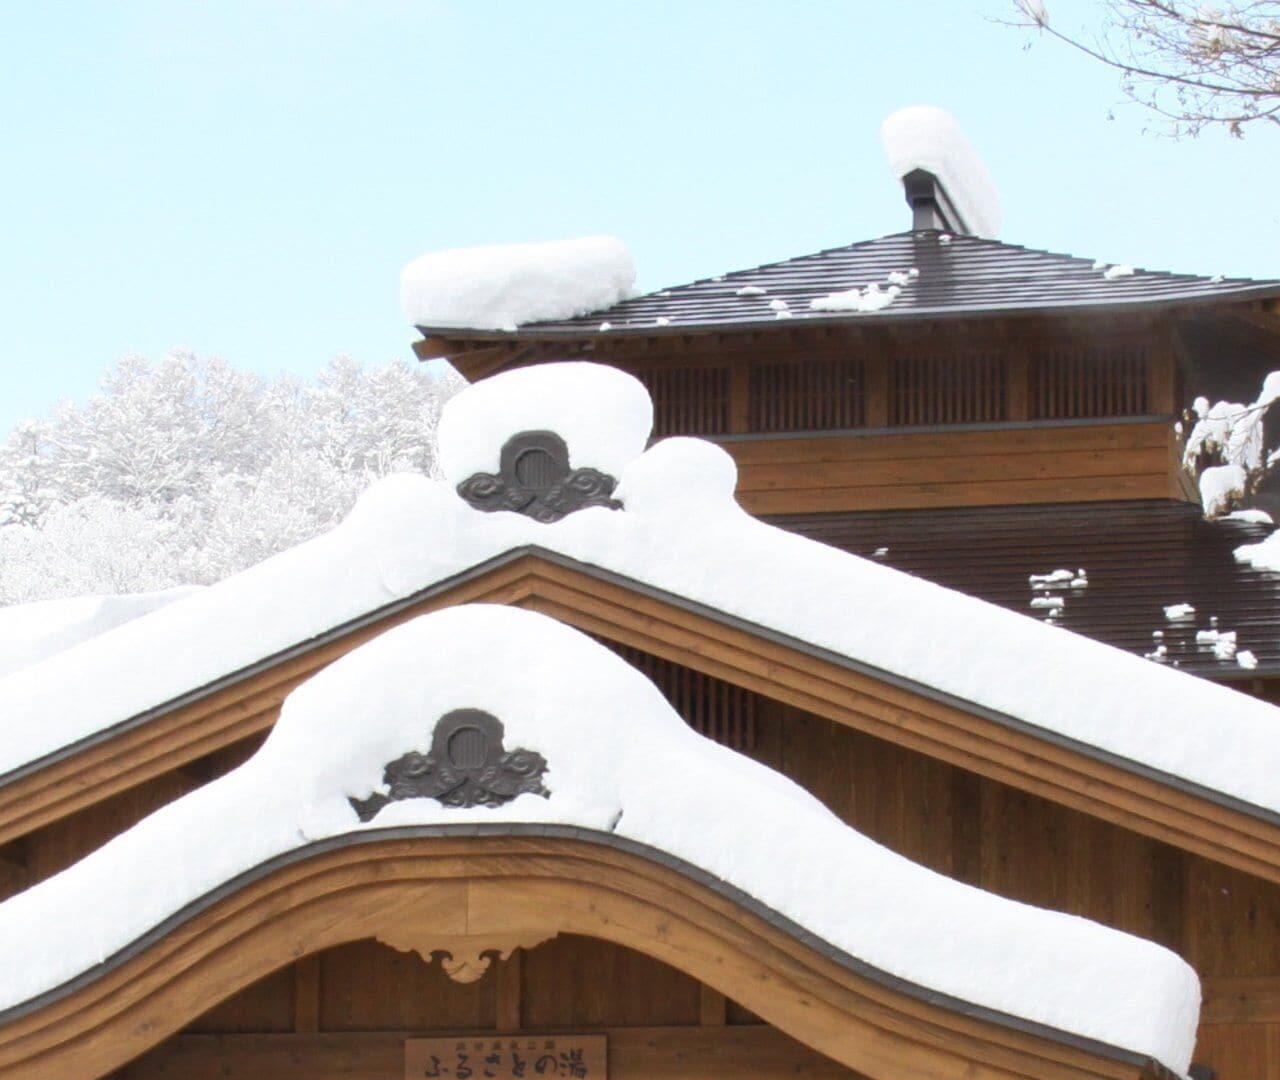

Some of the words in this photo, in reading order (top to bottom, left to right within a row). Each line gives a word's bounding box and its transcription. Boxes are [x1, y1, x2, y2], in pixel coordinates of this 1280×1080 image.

[425, 1048, 588, 1080] ふるさとの湯
